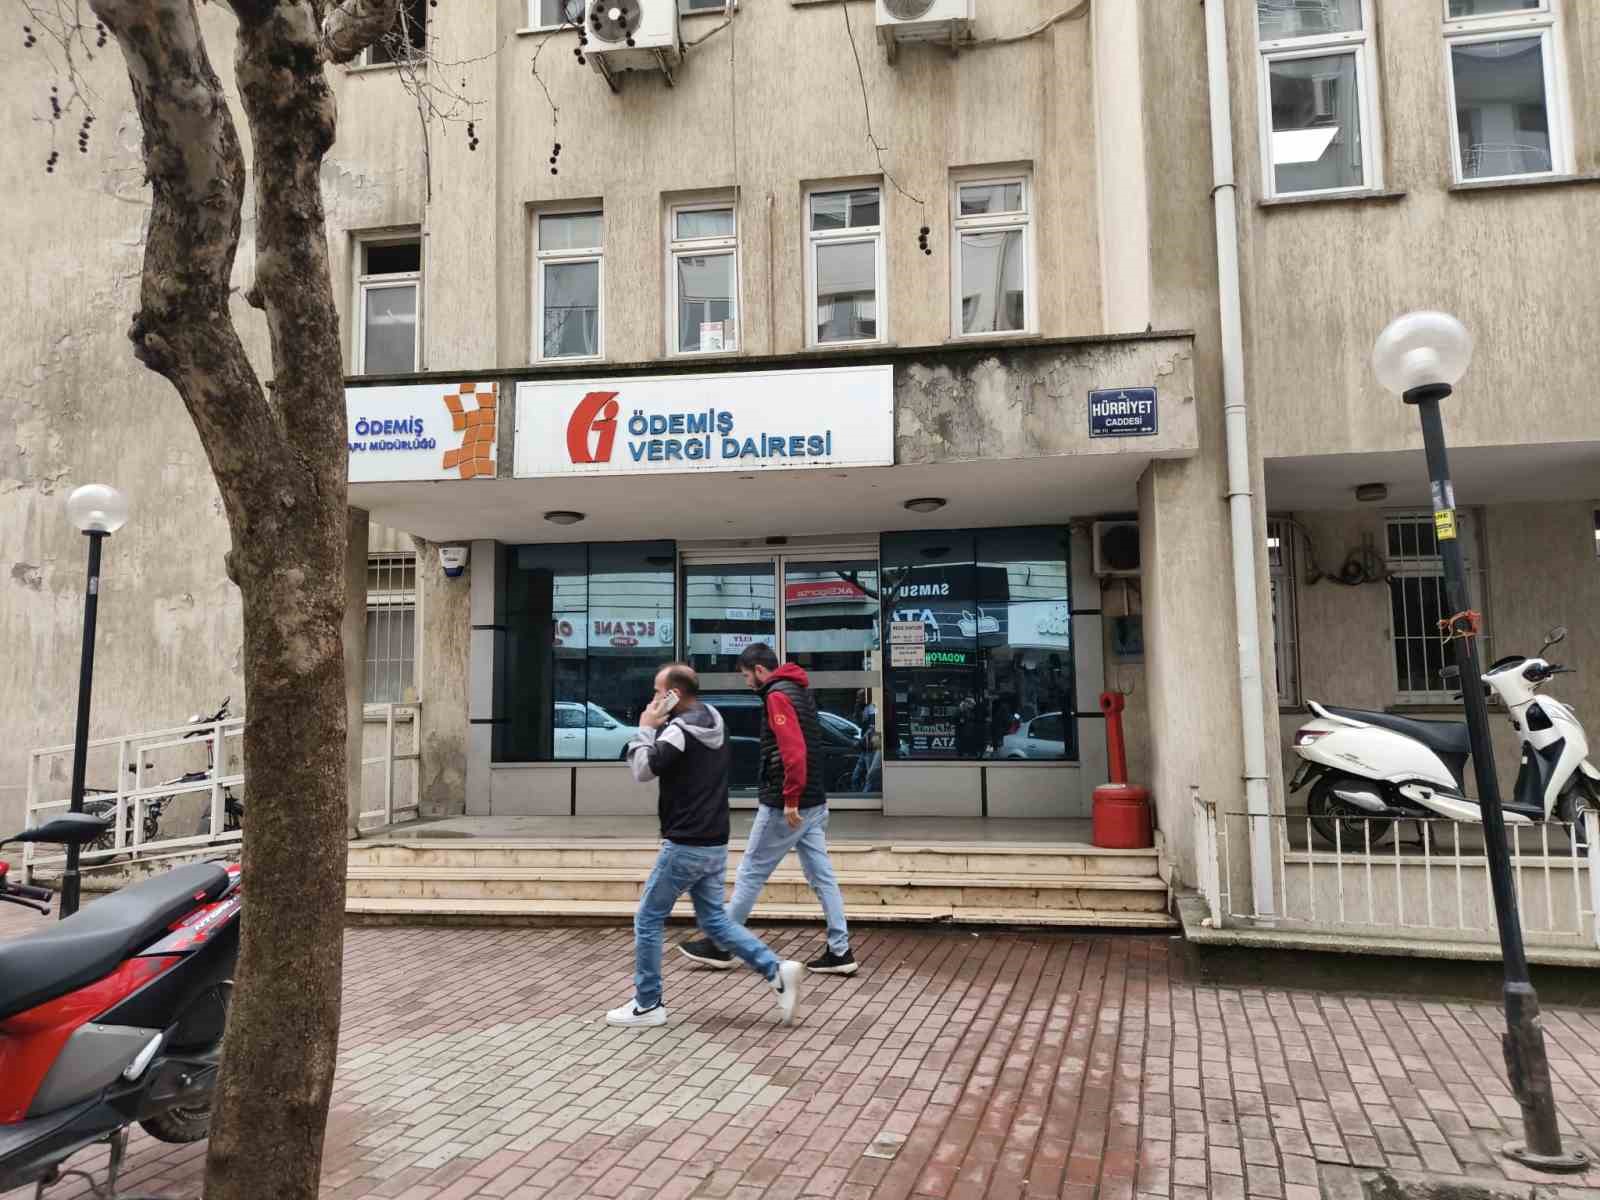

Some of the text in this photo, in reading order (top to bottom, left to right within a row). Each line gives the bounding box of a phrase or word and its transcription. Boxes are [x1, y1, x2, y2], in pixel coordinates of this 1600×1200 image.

[1092, 399, 1153, 416] HÜRRİYET
[355, 415, 424, 437] ÖDEMİŞ
[628, 408, 734, 437] ÖDEMİŞ
[1105, 416, 1143, 427] CADDESİ
[369, 437, 437, 452] MÜDÜRLÜĞÜ
[627, 430, 832, 462] VERGİ DAİRESİ
